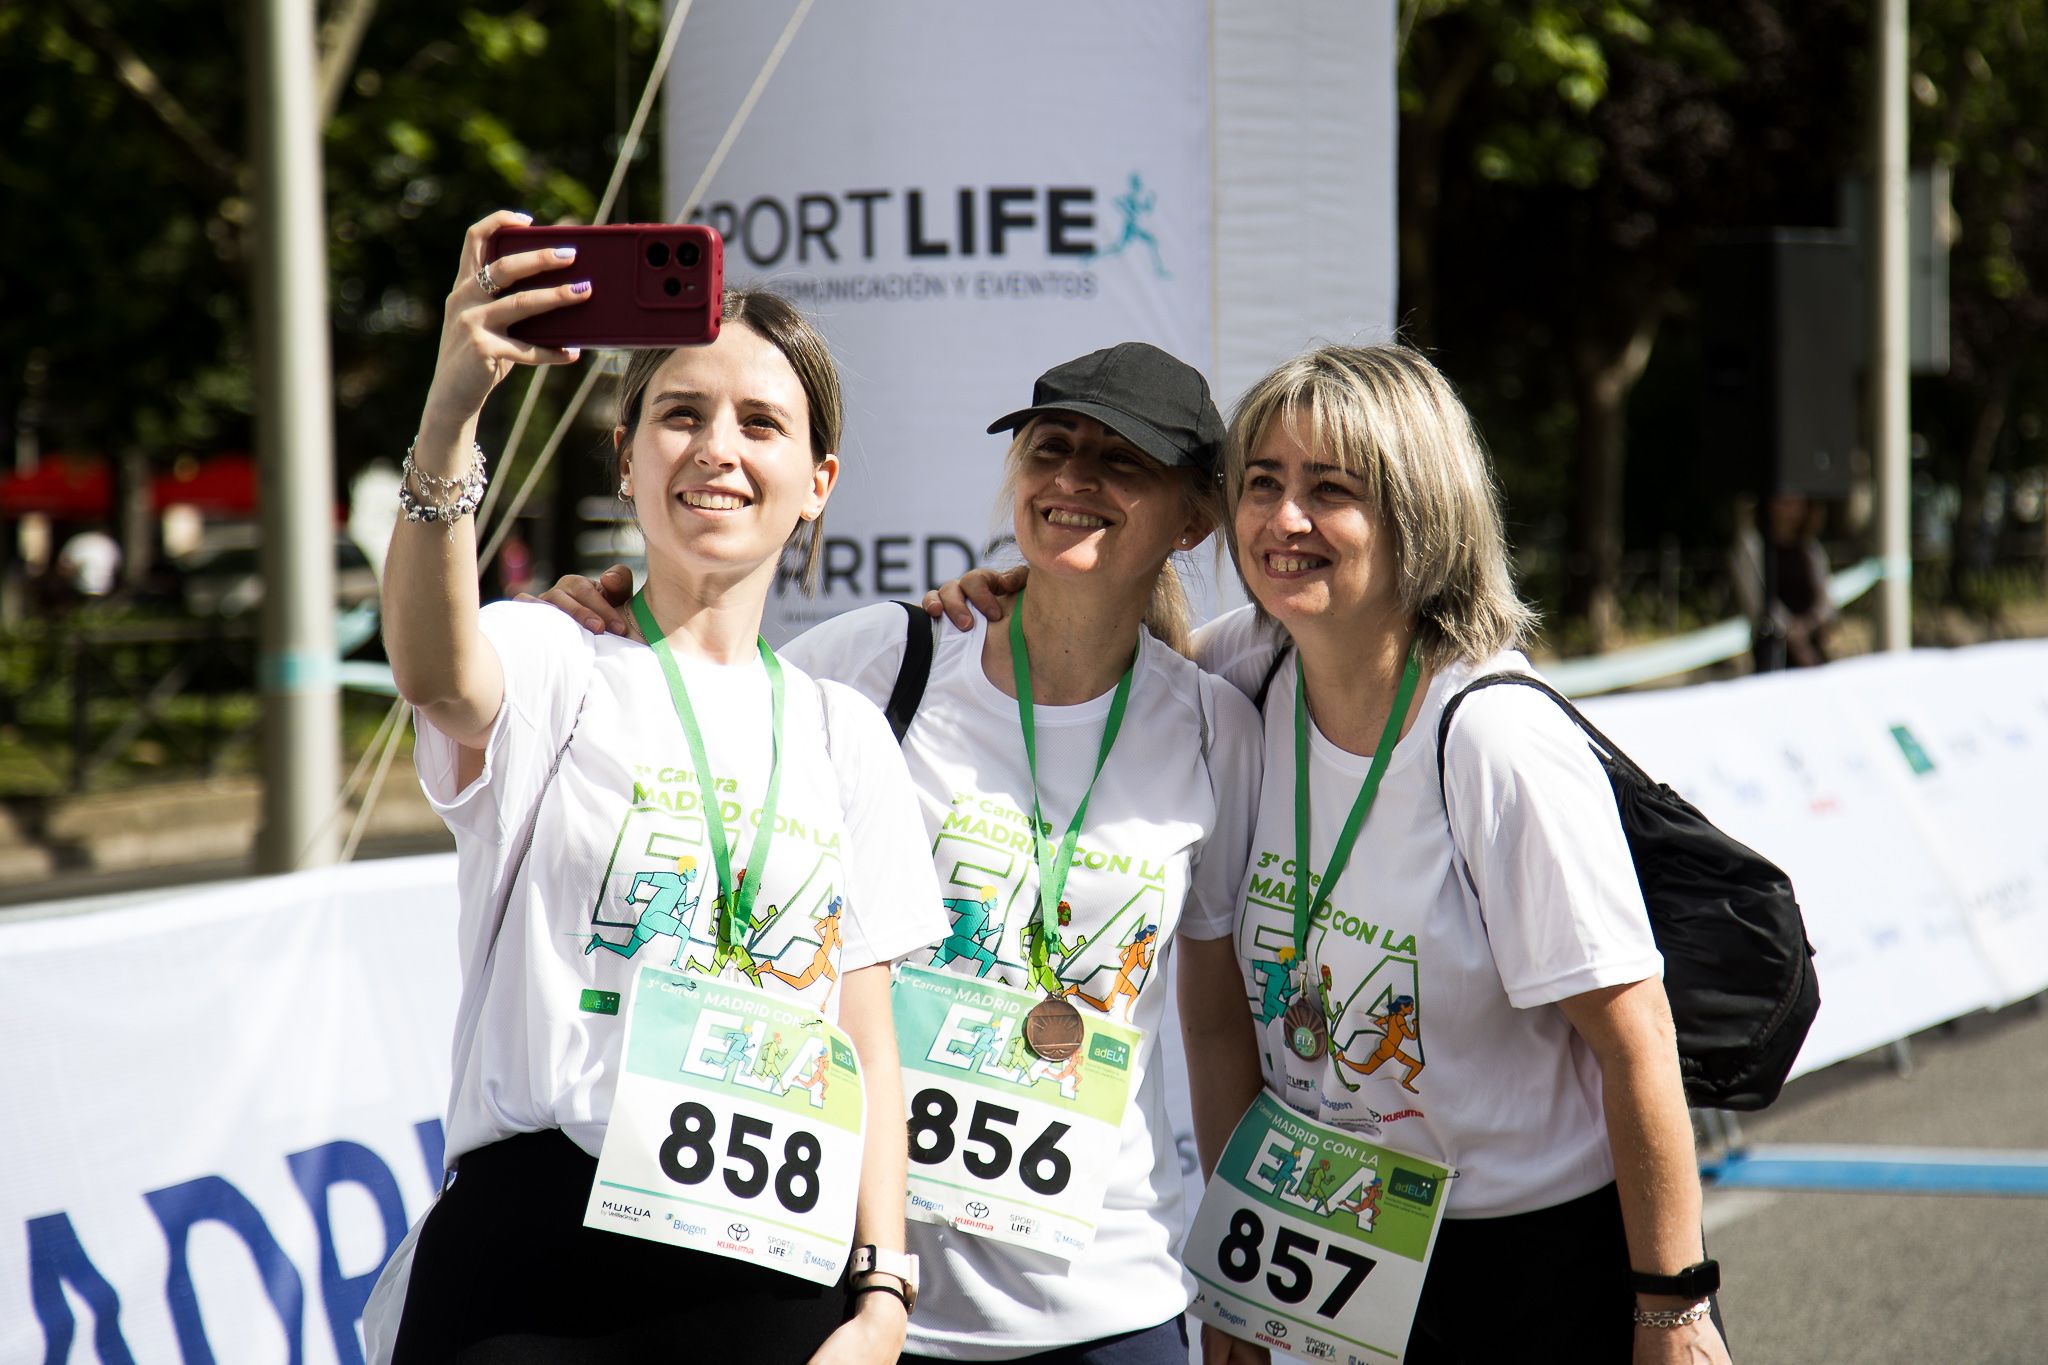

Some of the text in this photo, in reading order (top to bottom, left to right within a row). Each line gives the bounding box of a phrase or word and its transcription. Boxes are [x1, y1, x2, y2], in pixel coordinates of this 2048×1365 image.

[905, 187, 1097, 258] LIFE
[975, 270, 1097, 299] EVENTOS
[658, 767, 738, 793] Carra
[632, 781, 742, 823] MADD
[1138, 859, 1165, 884] LA
[1333, 910, 1379, 945] CON
[1380, 929, 1417, 956] LA
[703, 991, 771, 1018] MADRID
[911, 978, 952, 996] Carrera
[955, 987, 1021, 1014] MADRID
[680, 1007, 824, 1109] ELA
[925, 1002, 1077, 1101] ELA
[1094, 1047, 1125, 1065] adELA
[906, 1088, 1072, 1196] 856
[1271, 1113, 1320, 1146] MADRID
[1322, 1139, 1357, 1159] CON
[1359, 1151, 1380, 1167] LA
[659, 1101, 822, 1214] 858
[1244, 1127, 1377, 1233] ELA
[1394, 1182, 1429, 1201] adELA
[601, 1200, 651, 1218] MUKUA
[911, 1194, 945, 1212] Biogen
[673, 1219, 707, 1236] Biogen
[1011, 1223, 1031, 1235] LIFE
[767, 1235, 791, 1248] SPORT
[768, 1245, 786, 1258] LIFE
[810, 1255, 837, 1272] MADRID
[1217, 1207, 1378, 1320] 857
[1218, 1306, 1247, 1328] Biogen
[1305, 1336, 1330, 1350] SPORT
[1306, 1345, 1326, 1359] LIFE
